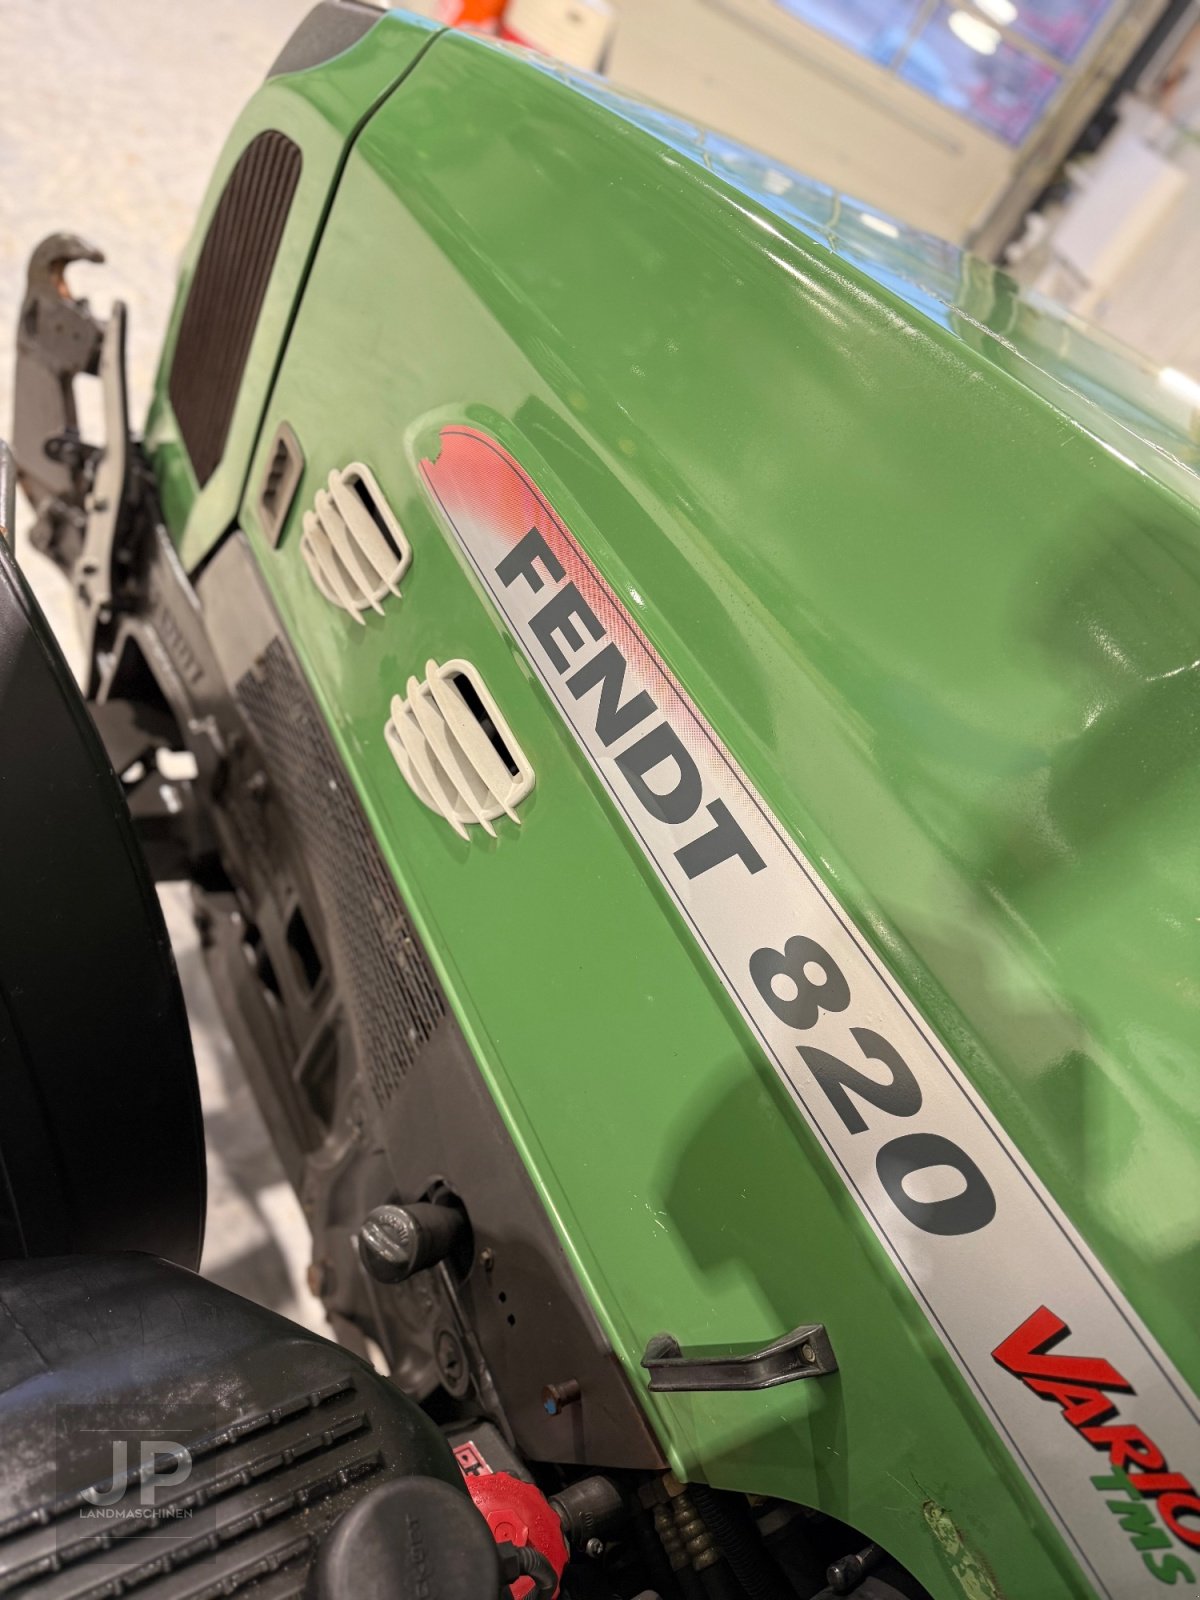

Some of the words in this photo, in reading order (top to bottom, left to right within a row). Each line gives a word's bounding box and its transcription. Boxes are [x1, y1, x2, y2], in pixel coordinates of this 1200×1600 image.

[495, 526, 767, 880] FENDT
[749, 935, 997, 1236] 820
[991, 1305, 1200, 1553] VARIO
[1090, 1464, 1197, 1585] TMS
